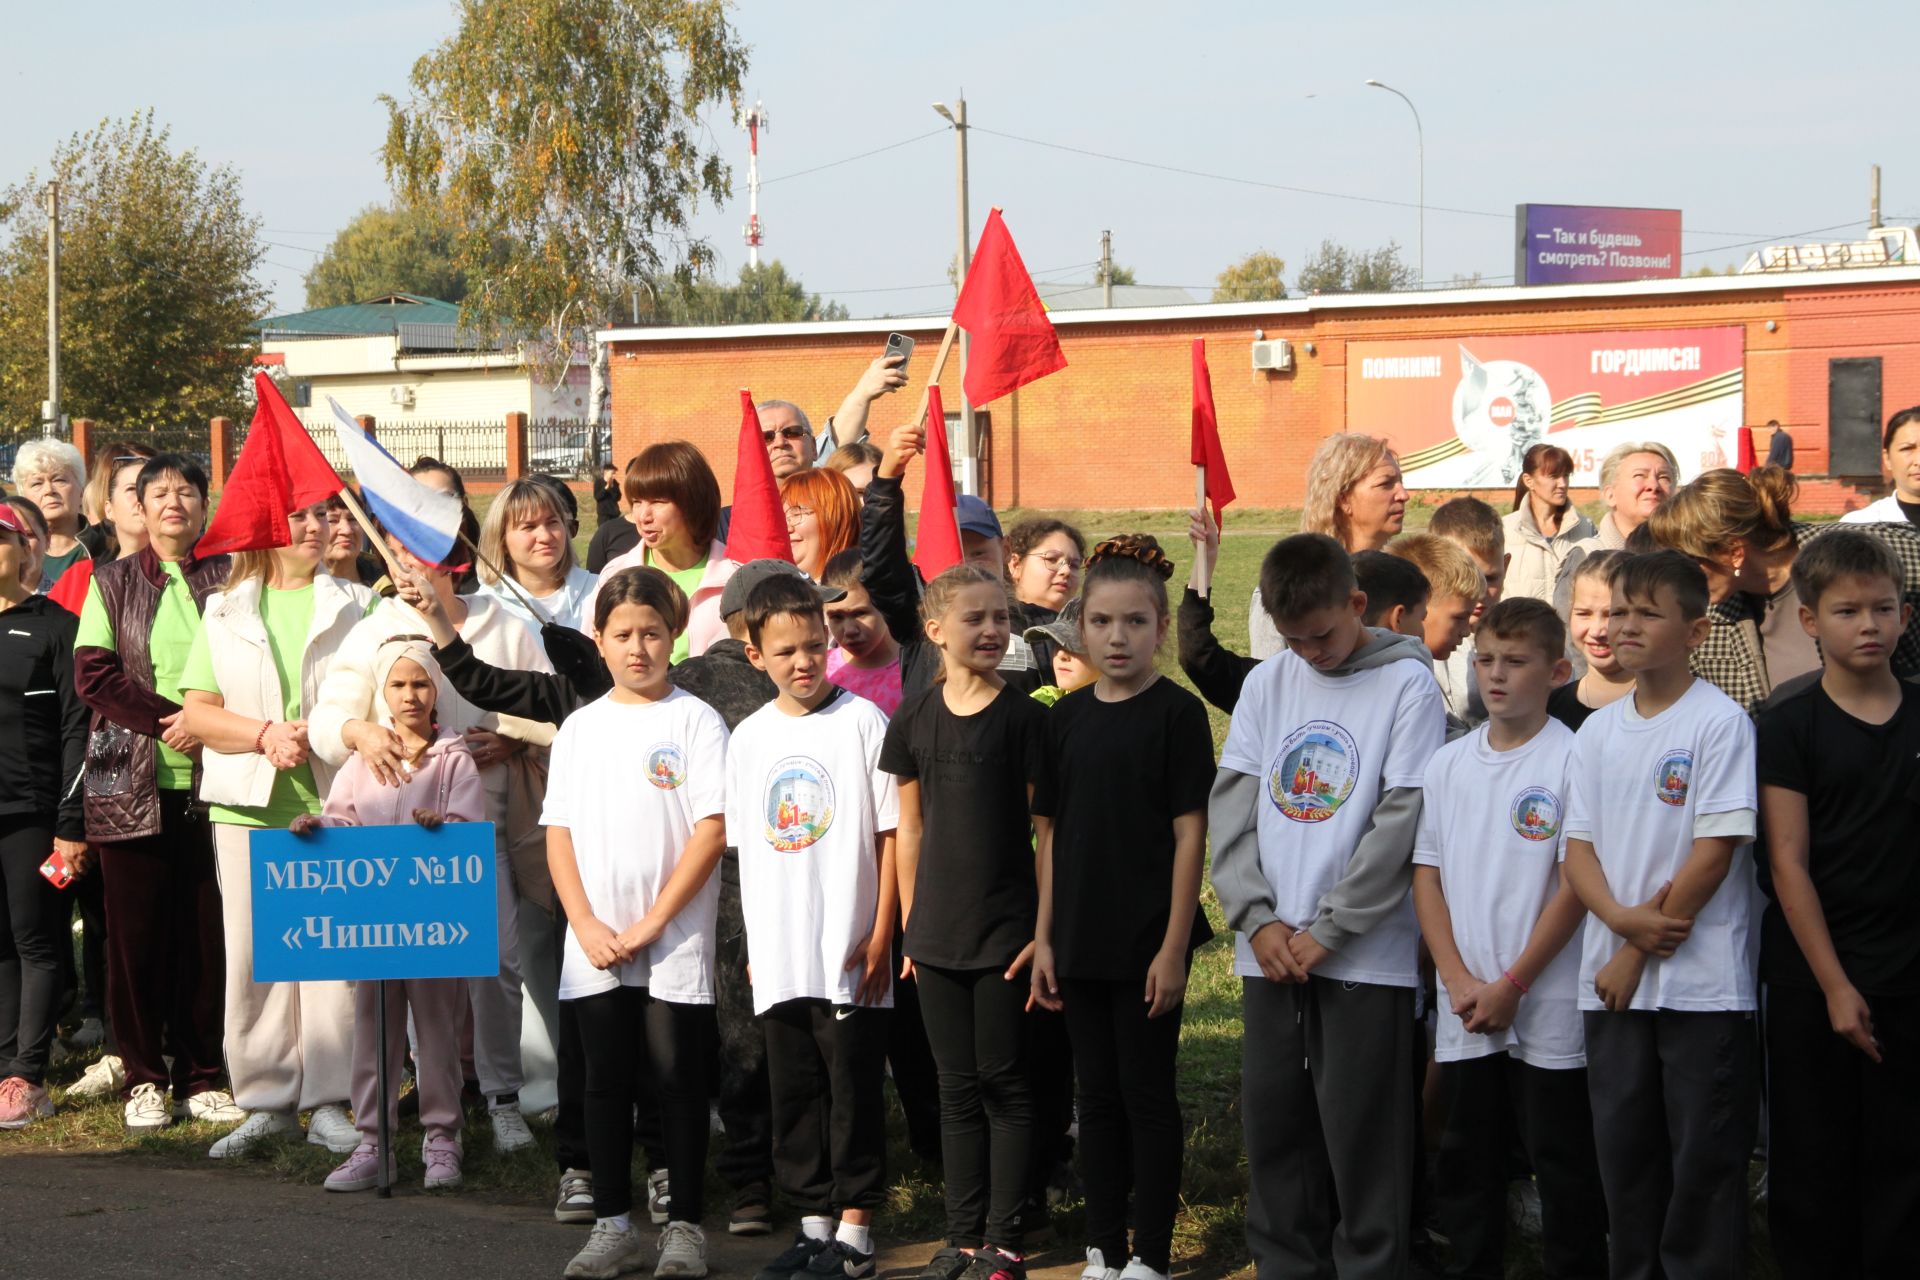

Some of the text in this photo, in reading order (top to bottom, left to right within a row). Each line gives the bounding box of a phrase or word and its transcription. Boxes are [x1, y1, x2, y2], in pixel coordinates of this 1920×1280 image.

[1553, 228, 1576, 244] Так
[1578, 233, 1587, 245] и
[1589, 229, 1642, 249] будешь
[1538, 252, 1671, 269] смотреть? Позвони!
[1362, 356, 1441, 379] ПОМНИМ!
[1591, 347, 1700, 376] ГОРДИМСЯ!
[1303, 770, 1317, 794] 1
[790, 804, 801, 827] 1
[264, 854, 483, 895] МБДОУ №10
[281, 915, 470, 950] «Чишма»
